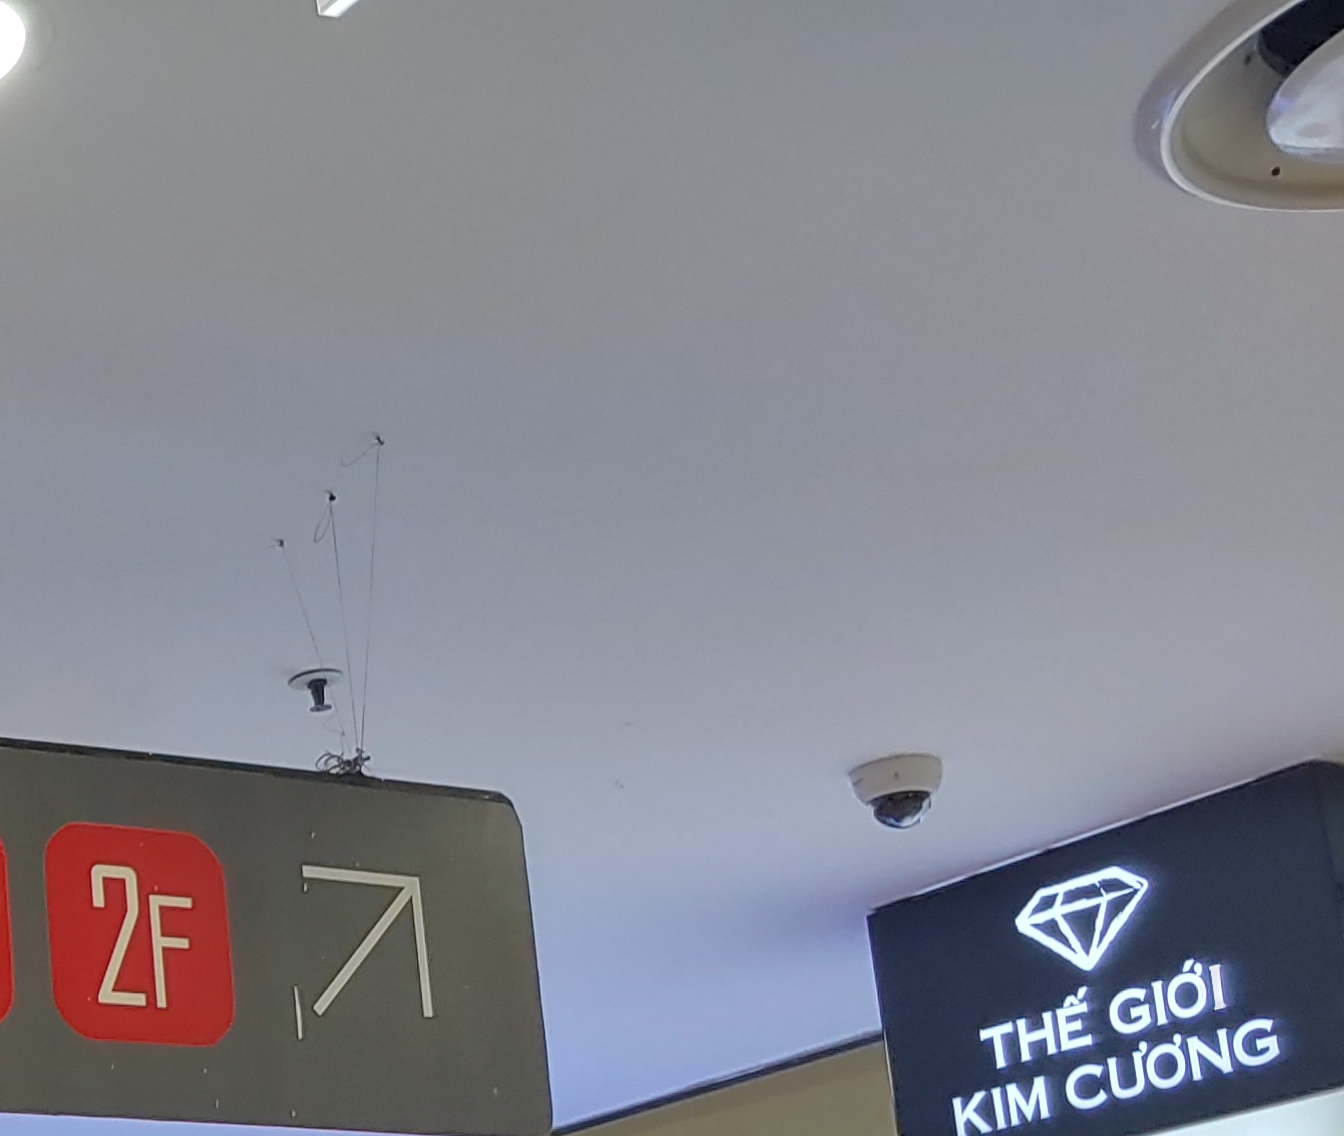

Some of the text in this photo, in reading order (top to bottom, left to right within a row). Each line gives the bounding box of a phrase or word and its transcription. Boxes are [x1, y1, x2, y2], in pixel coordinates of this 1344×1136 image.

[90, 864, 202, 1009] 2F
[979, 958, 1230, 1070] THẾ GIỚI
[1065, 1018, 1281, 1111] CƯƠNG
